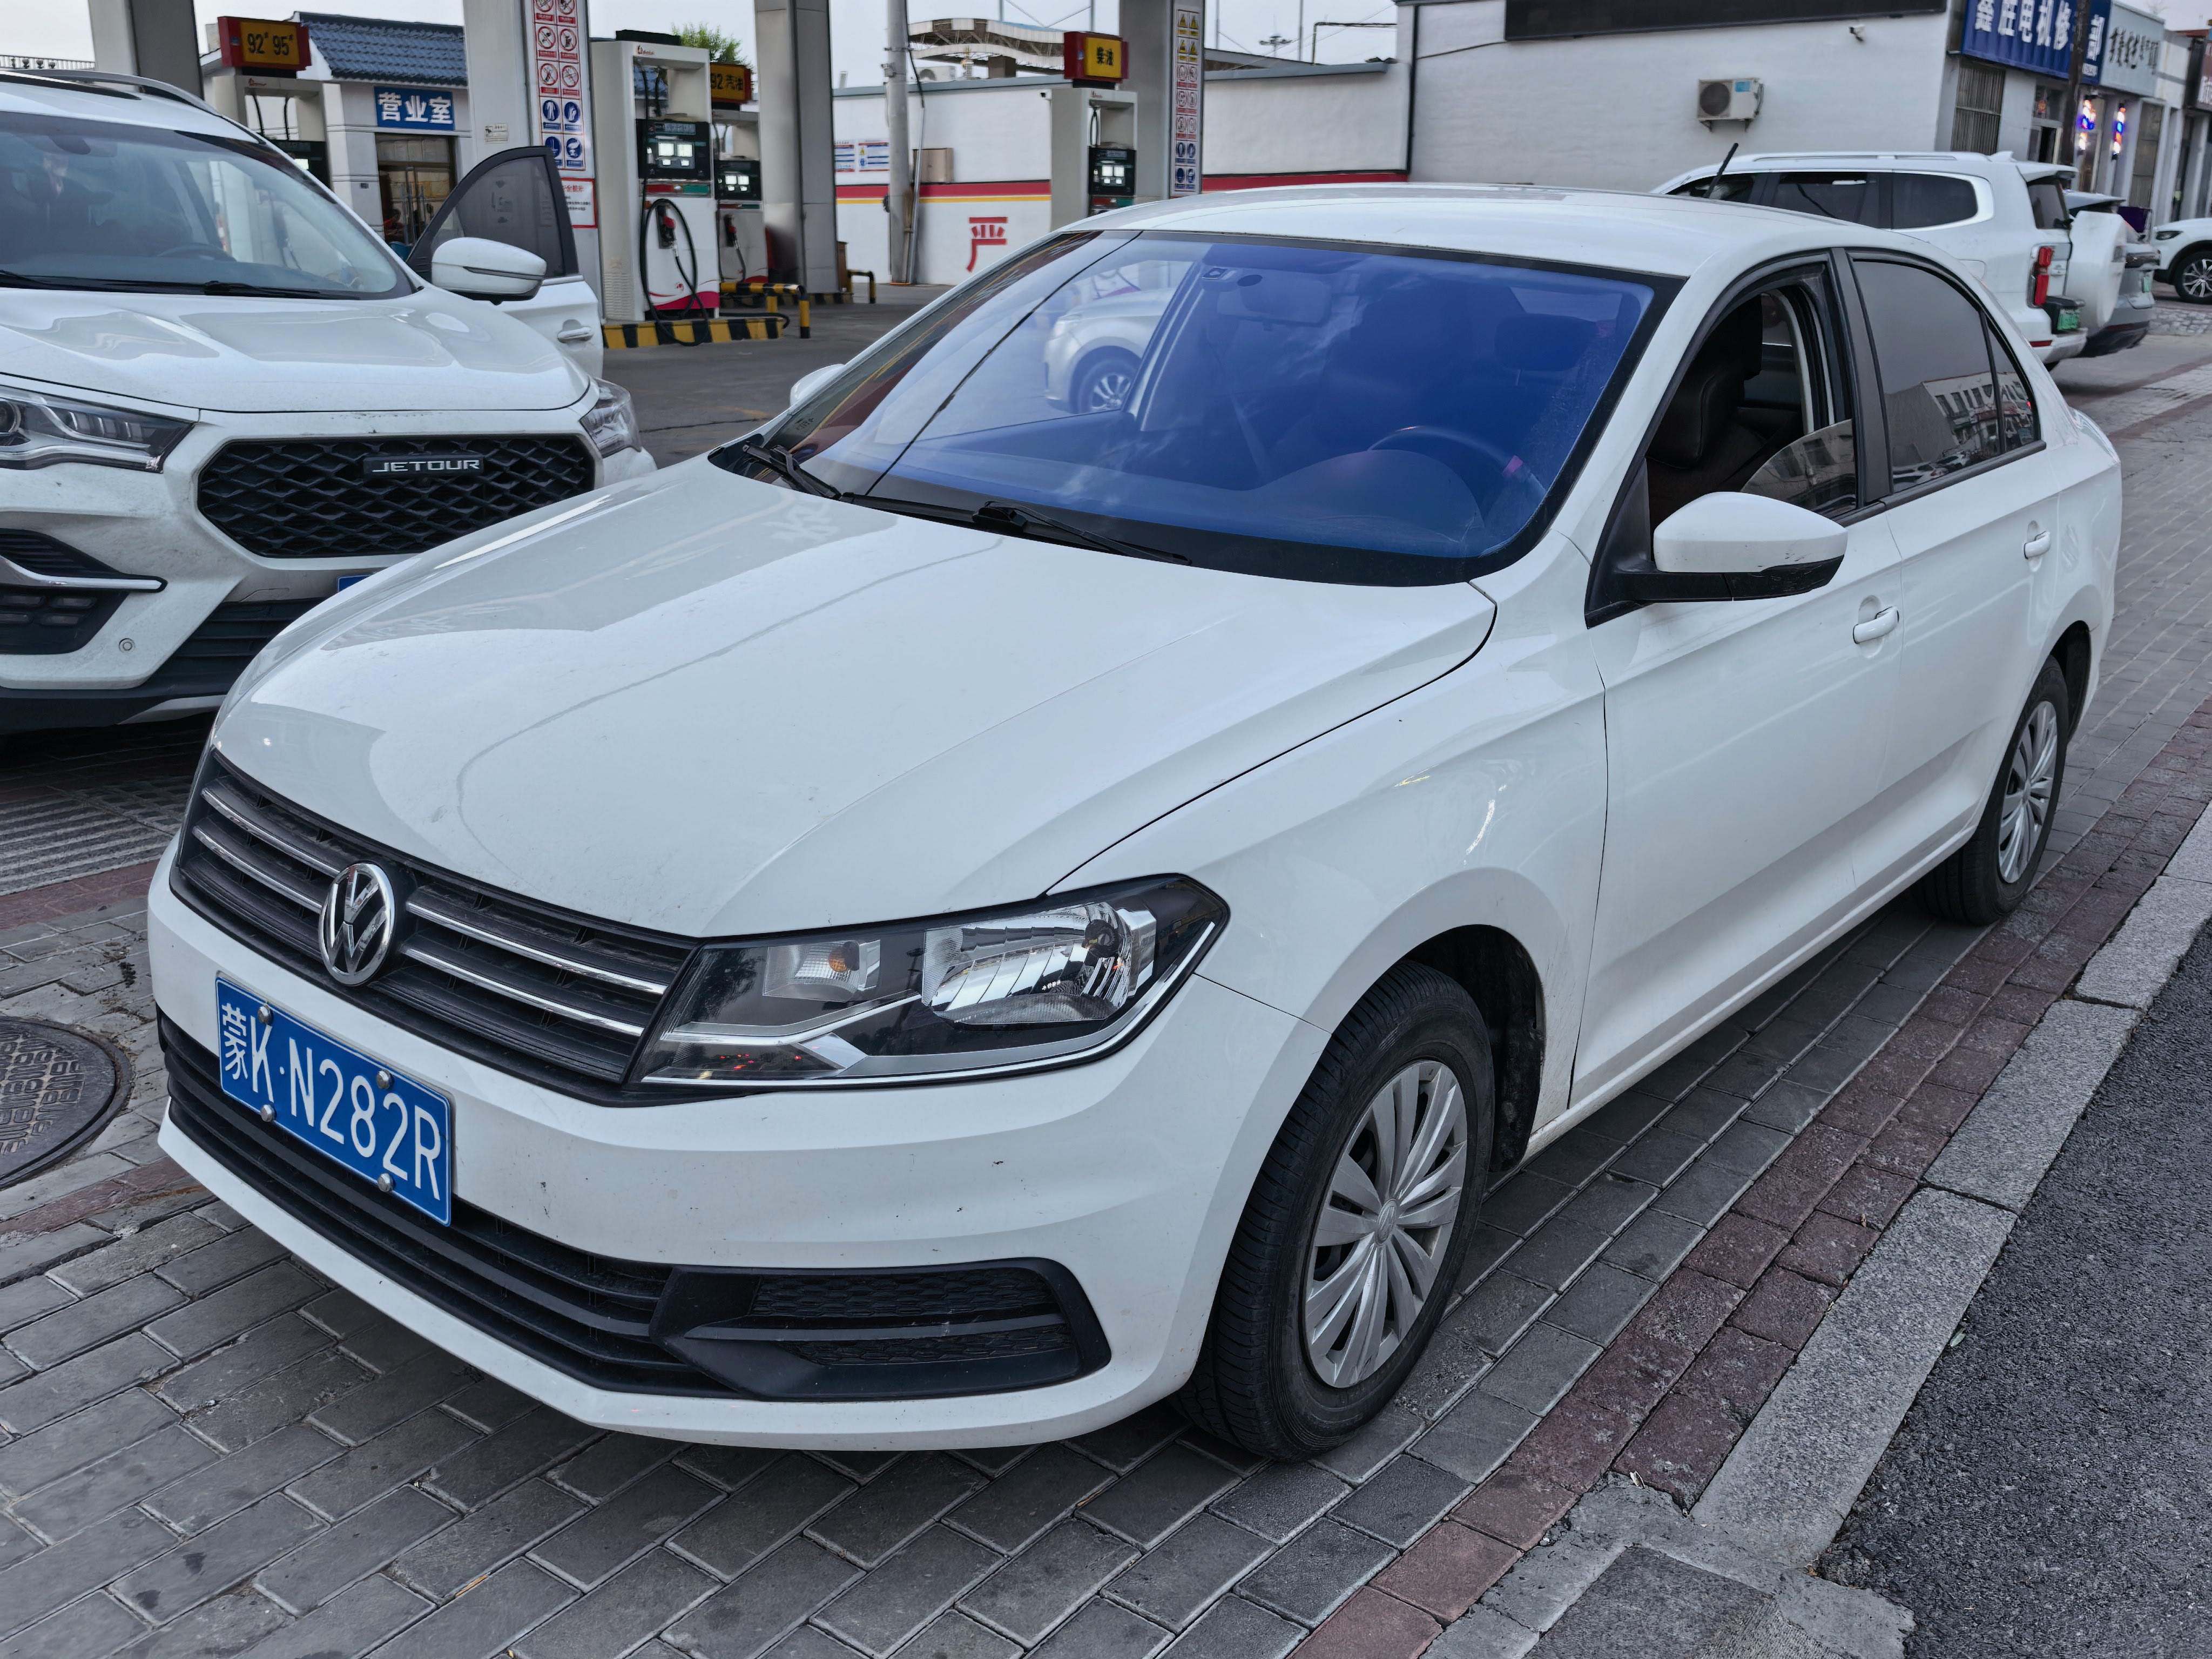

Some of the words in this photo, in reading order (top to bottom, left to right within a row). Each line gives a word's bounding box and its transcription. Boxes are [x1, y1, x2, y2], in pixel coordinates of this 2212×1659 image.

[379, 92, 453, 124] 营业室
[966, 217, 1008, 272] 严
[372, 460, 480, 472] JETOUR
[221, 1002, 441, 1201] 蒙K·N282R
